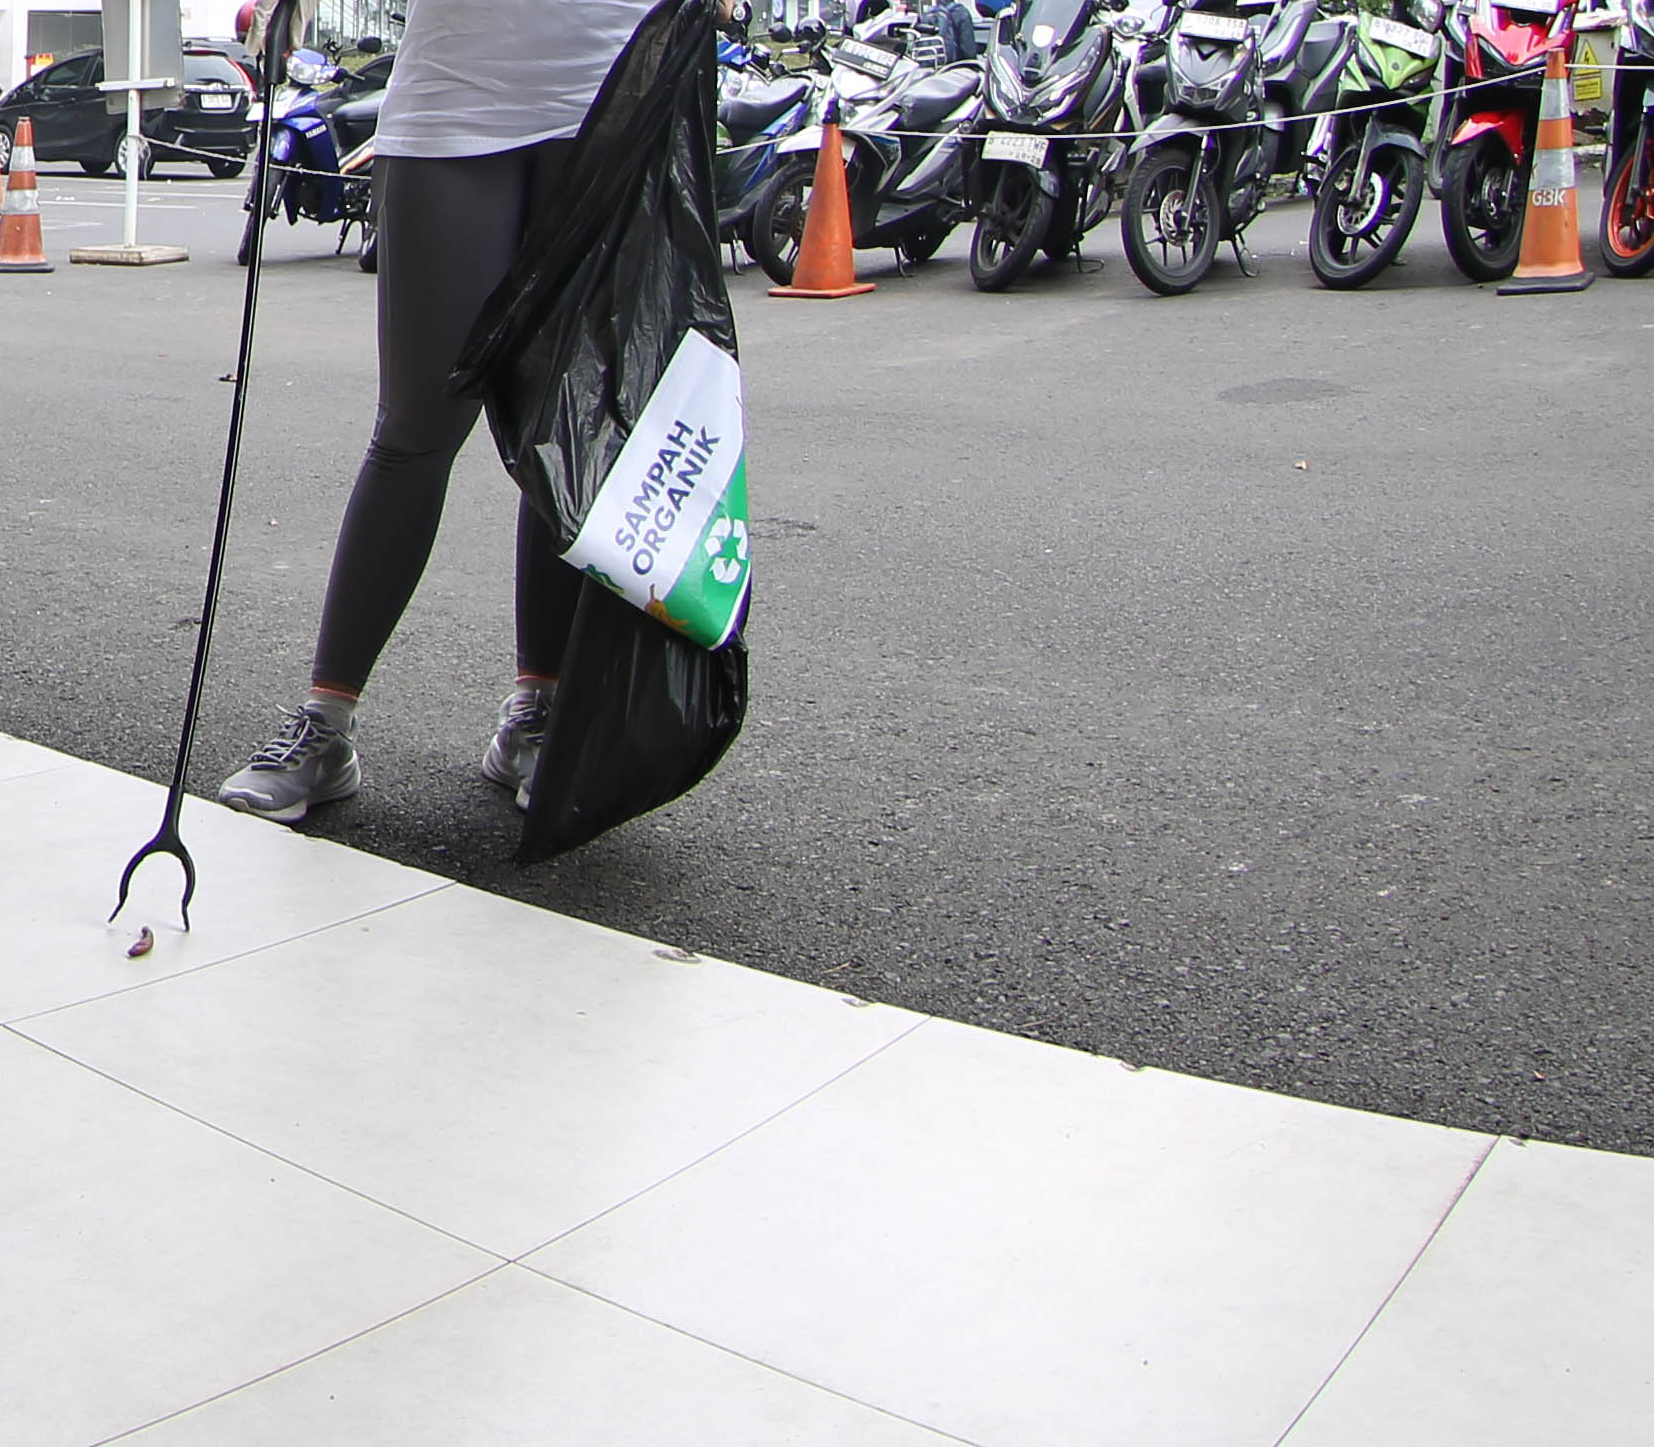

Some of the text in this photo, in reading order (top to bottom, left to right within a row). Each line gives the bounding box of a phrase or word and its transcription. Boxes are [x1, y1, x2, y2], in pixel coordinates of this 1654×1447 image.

[1532, 188, 1566, 206] GBK
[615, 419, 694, 552] SAMPAH
[631, 425, 724, 576] ORGANIK
